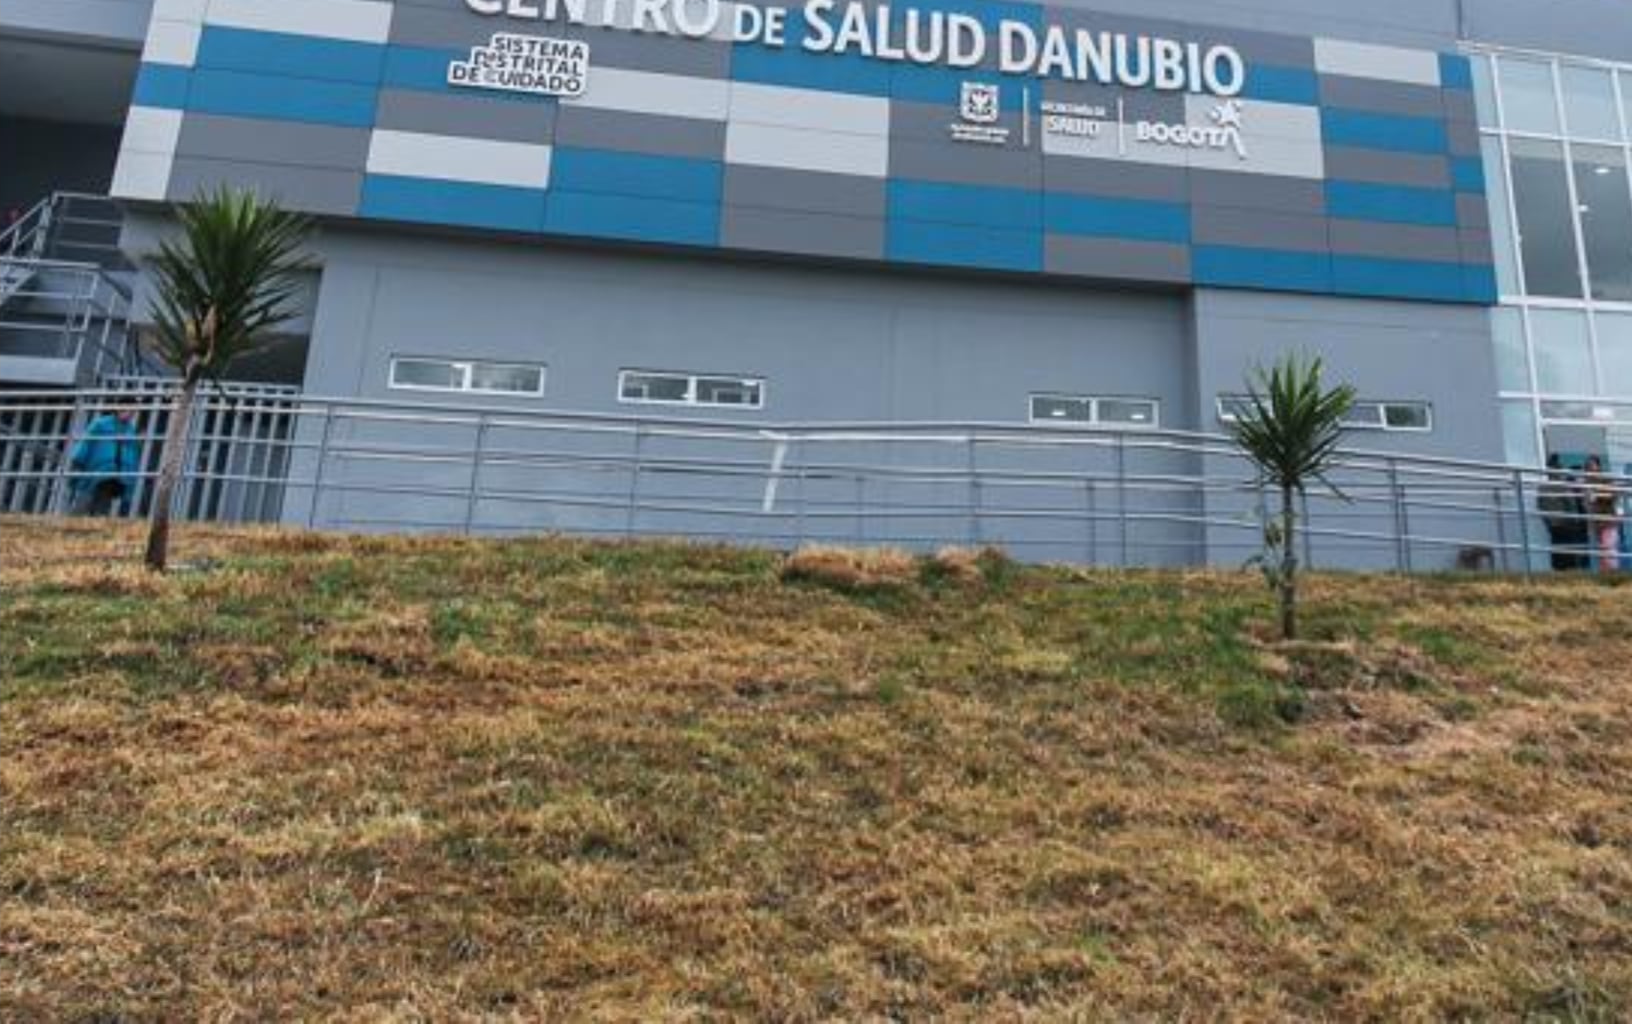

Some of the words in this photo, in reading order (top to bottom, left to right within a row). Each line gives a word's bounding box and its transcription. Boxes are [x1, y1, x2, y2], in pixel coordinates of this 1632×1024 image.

[495, 37, 584, 60] SISTEMA
[734, 3, 787, 45] DE
[999, 19, 1245, 97] DANUBIO
[453, 65, 481, 83] DE
